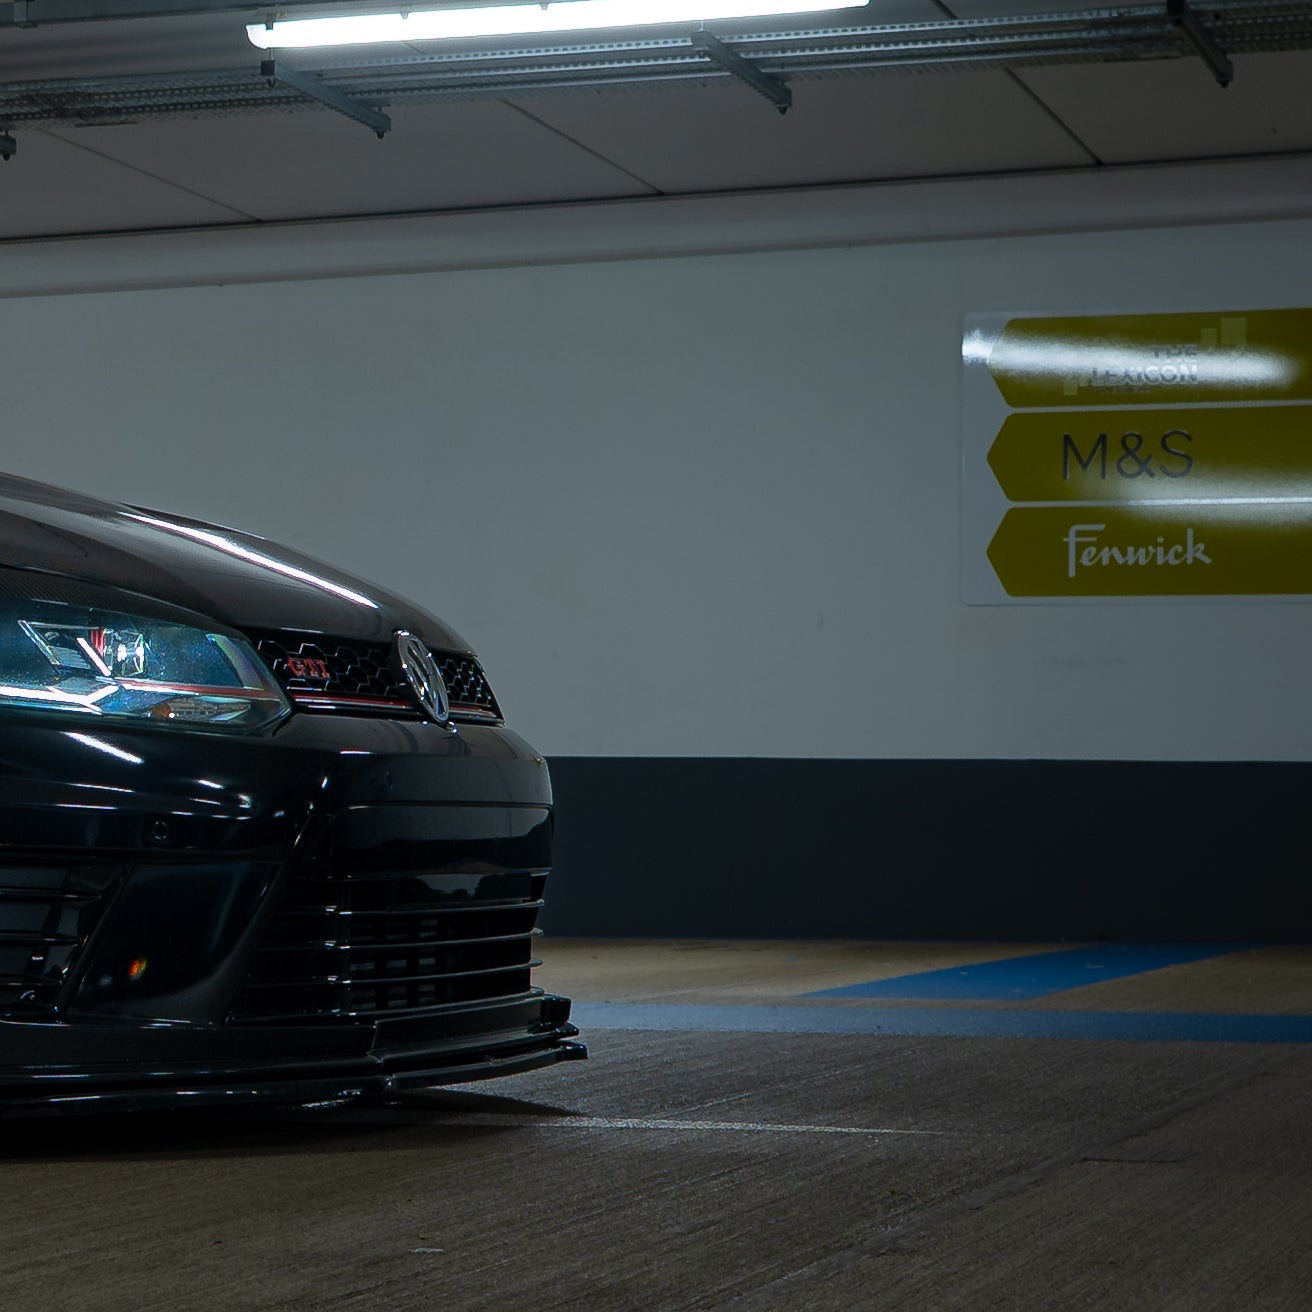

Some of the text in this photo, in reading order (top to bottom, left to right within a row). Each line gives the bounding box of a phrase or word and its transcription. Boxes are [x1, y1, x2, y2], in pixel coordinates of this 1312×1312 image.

[1061, 429, 1194, 480] M&S
[1062, 523, 1213, 579] Fenwick
[288, 657, 331, 679] GTI
